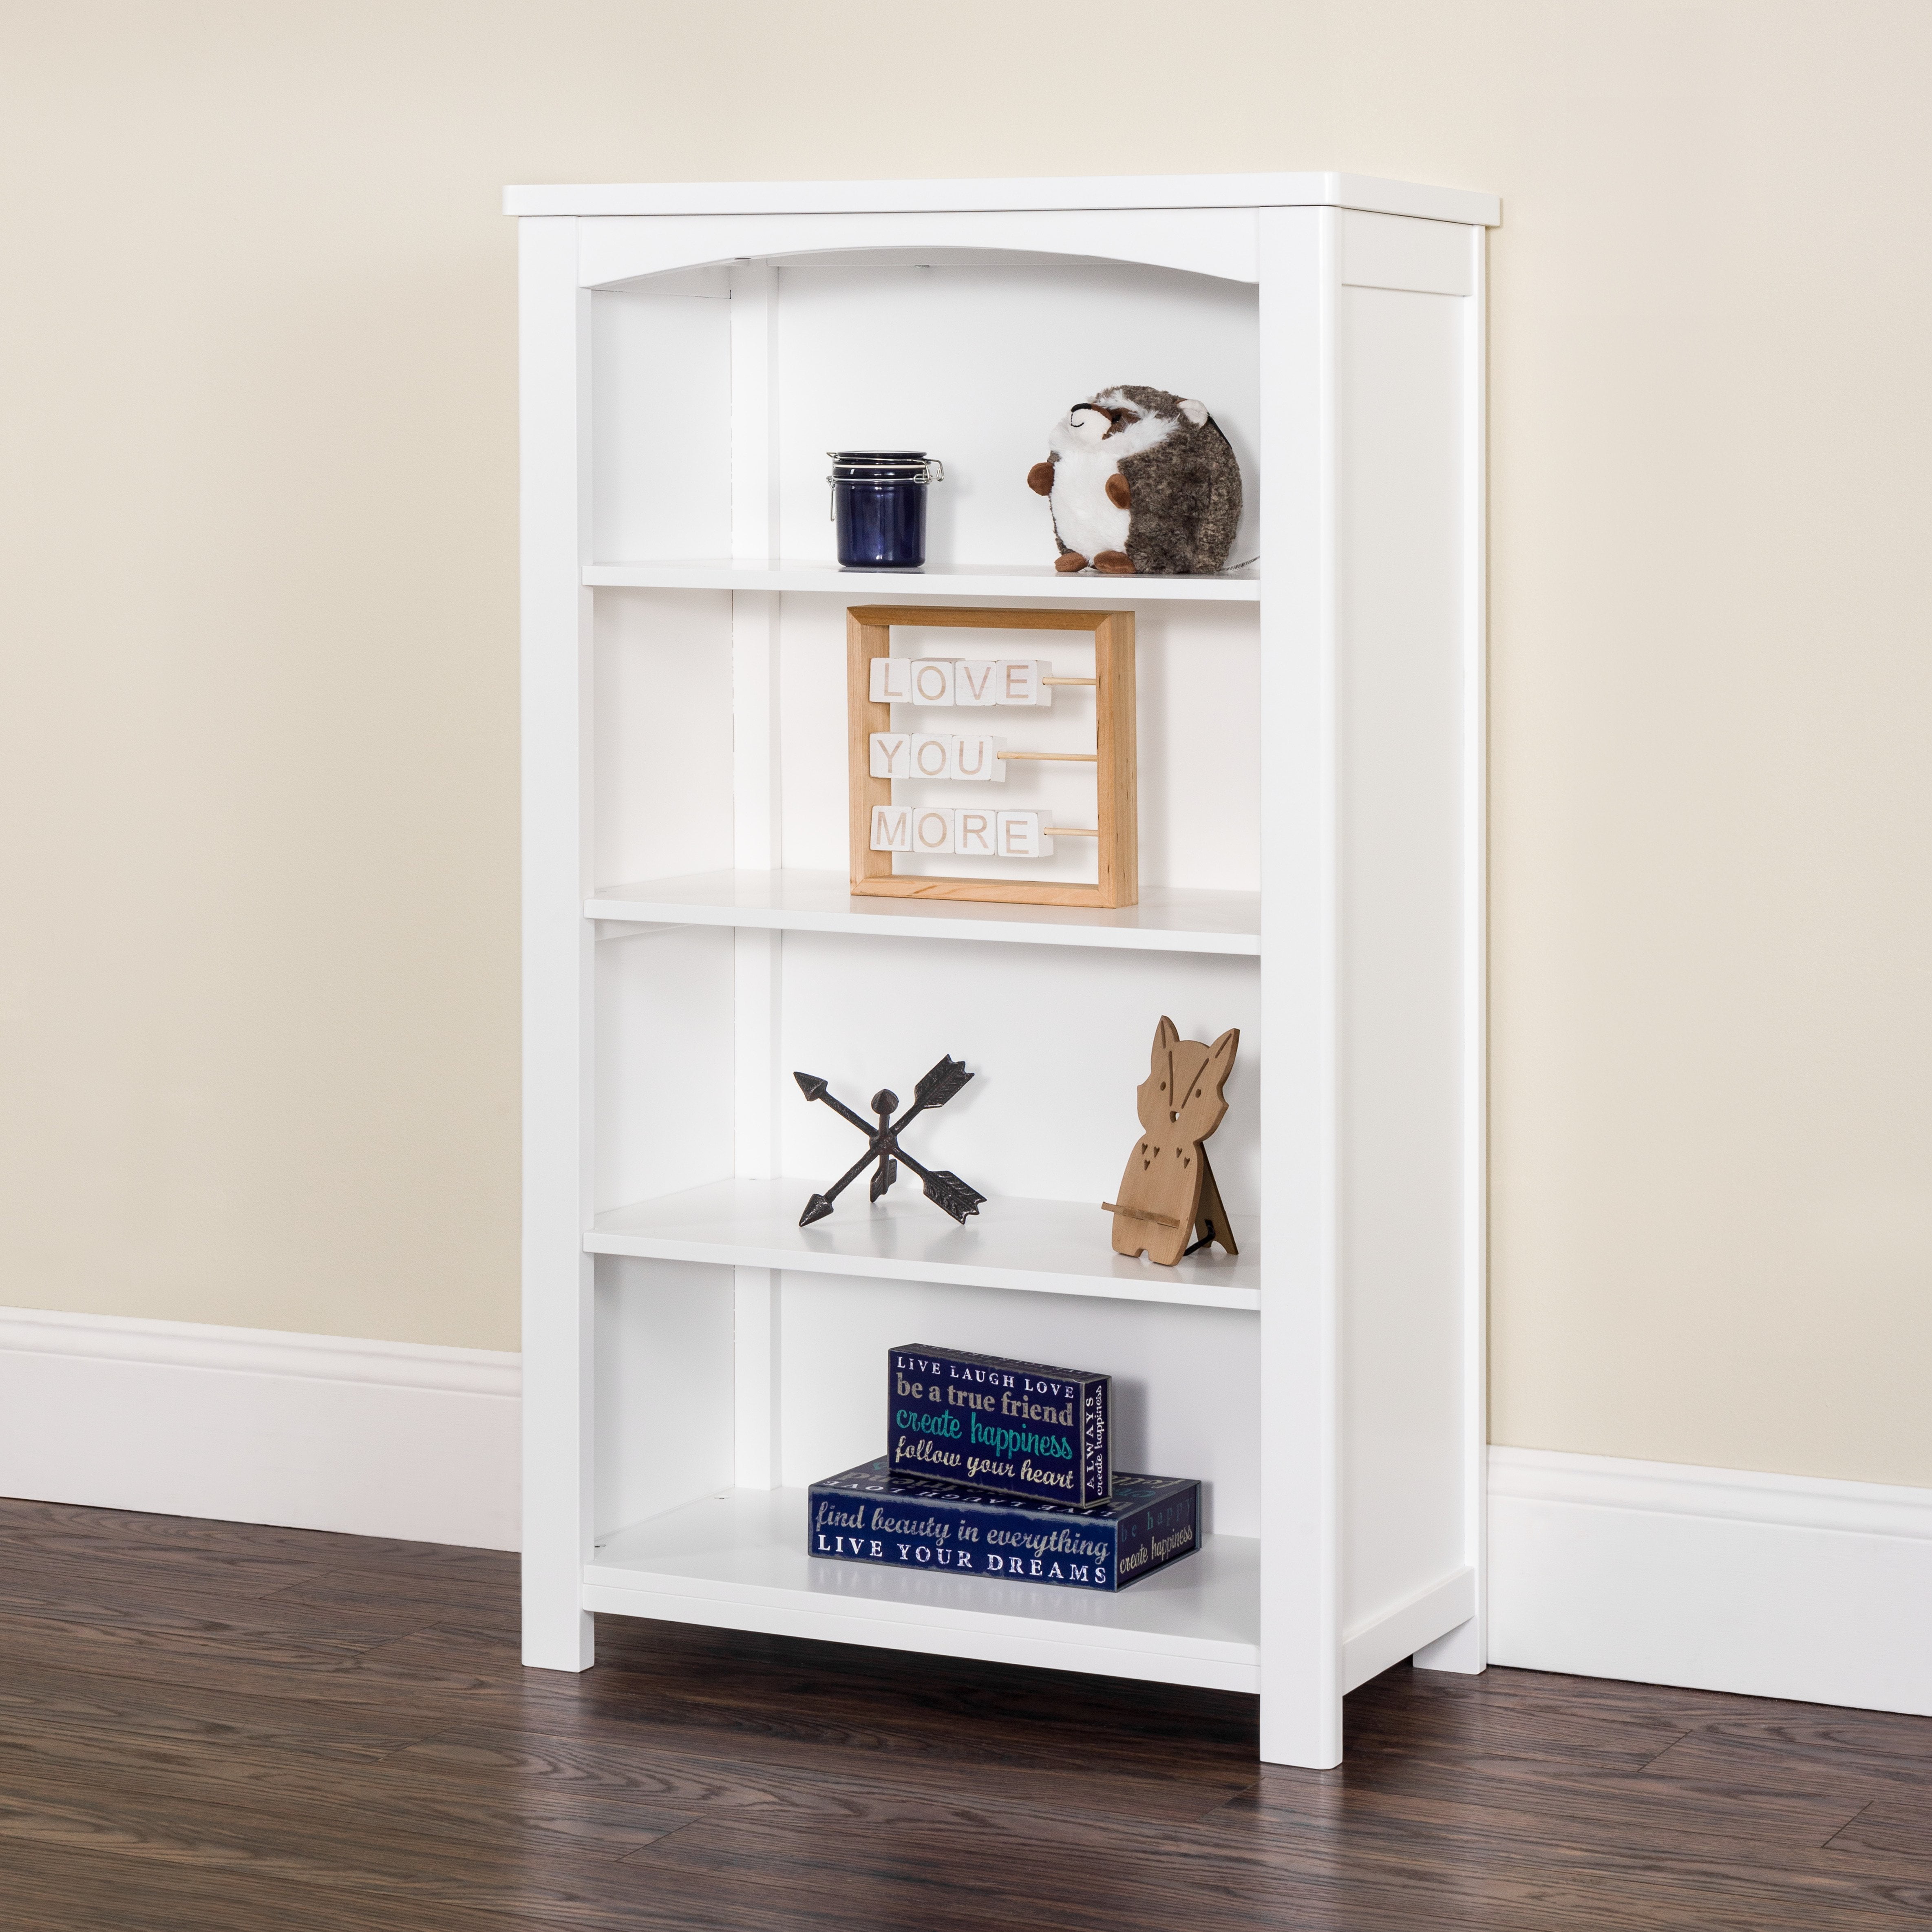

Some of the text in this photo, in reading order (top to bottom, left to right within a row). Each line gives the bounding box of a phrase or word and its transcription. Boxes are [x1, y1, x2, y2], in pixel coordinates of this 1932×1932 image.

[883, 663, 1029, 700] LOVE
[877, 740, 984, 775] YOU
[876, 811, 1029, 854] MORE
[896, 1372, 1074, 1426] be a true friend
[897, 1356, 941, 1375] LIVE
[950, 1365, 1015, 1388] LAUGH
[1024, 1379, 1074, 1399] LOVE
[896, 1409, 1073, 1459] create happiness
[1086, 1397, 1094, 1489] ALWAYS
[1094, 1385, 1104, 1496] create happiness
[895, 1435, 1074, 1489] follow your heart
[816, 1501, 1110, 1565] find beauty in everything
[1121, 1498, 1193, 1542] be happy
[818, 1534, 1106, 1583] LIVE YOUR DREAMS
[1120, 1525, 1192, 1574] create happiness
